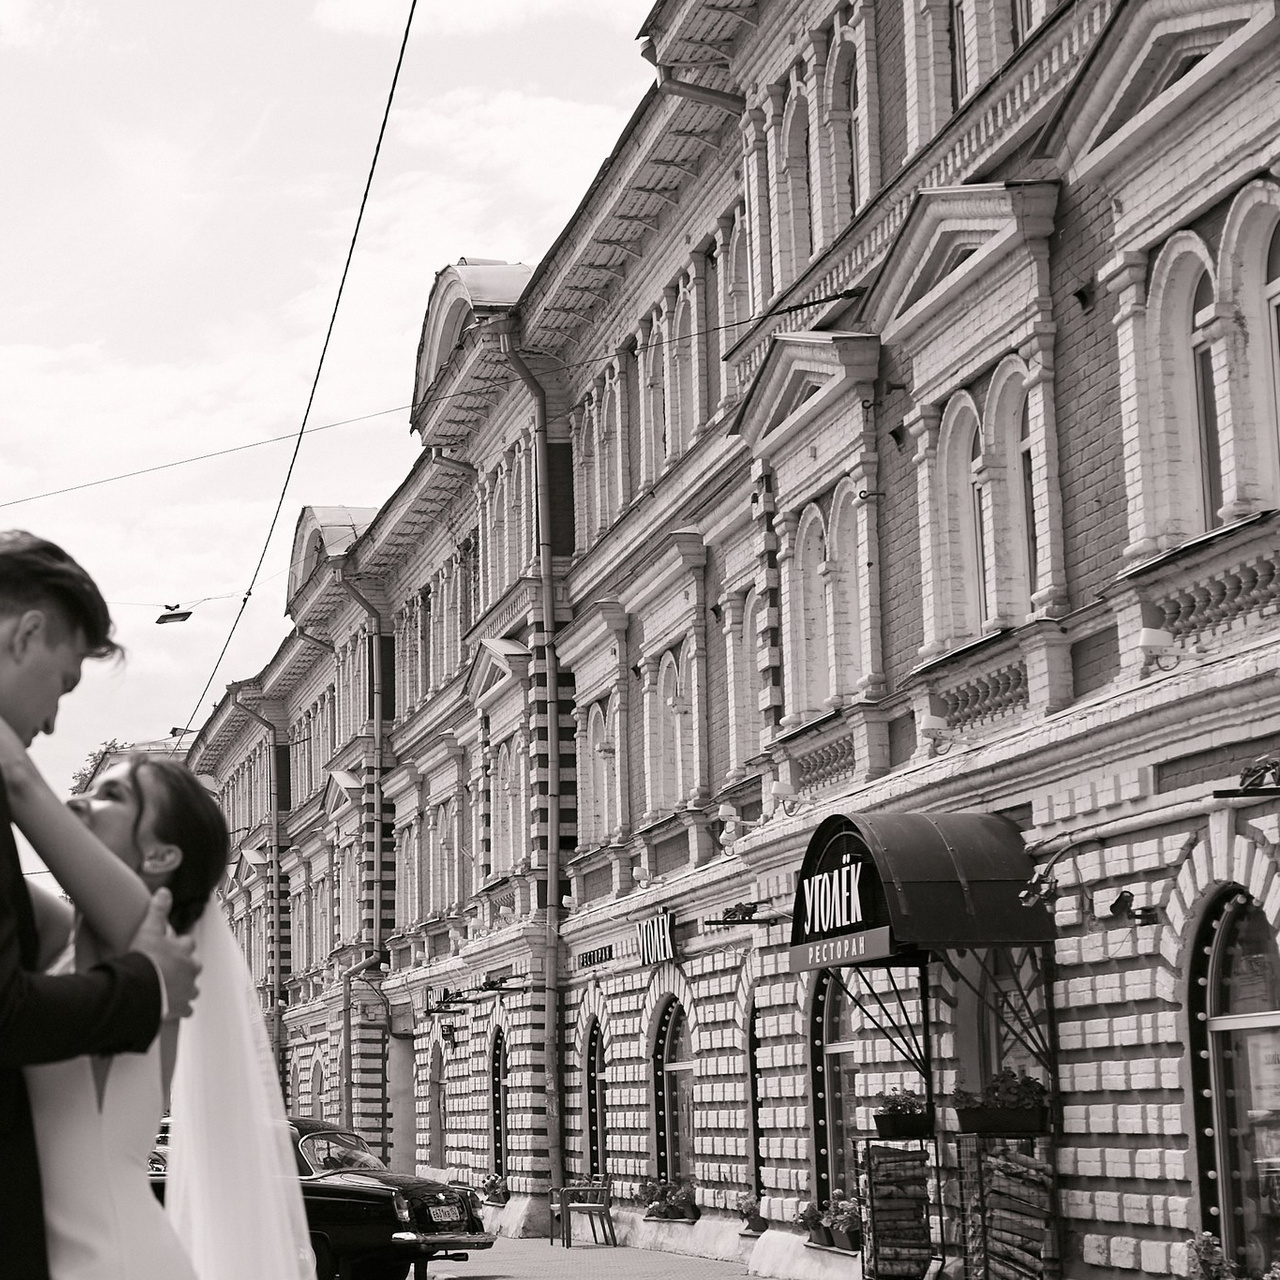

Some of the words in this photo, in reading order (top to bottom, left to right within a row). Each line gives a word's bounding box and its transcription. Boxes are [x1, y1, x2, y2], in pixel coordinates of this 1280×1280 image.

[803, 853, 862, 935] УГОЛЁК
[636, 907, 673, 966] УГОЛЁК
[808, 936, 865, 965] РЕСТОРАН
